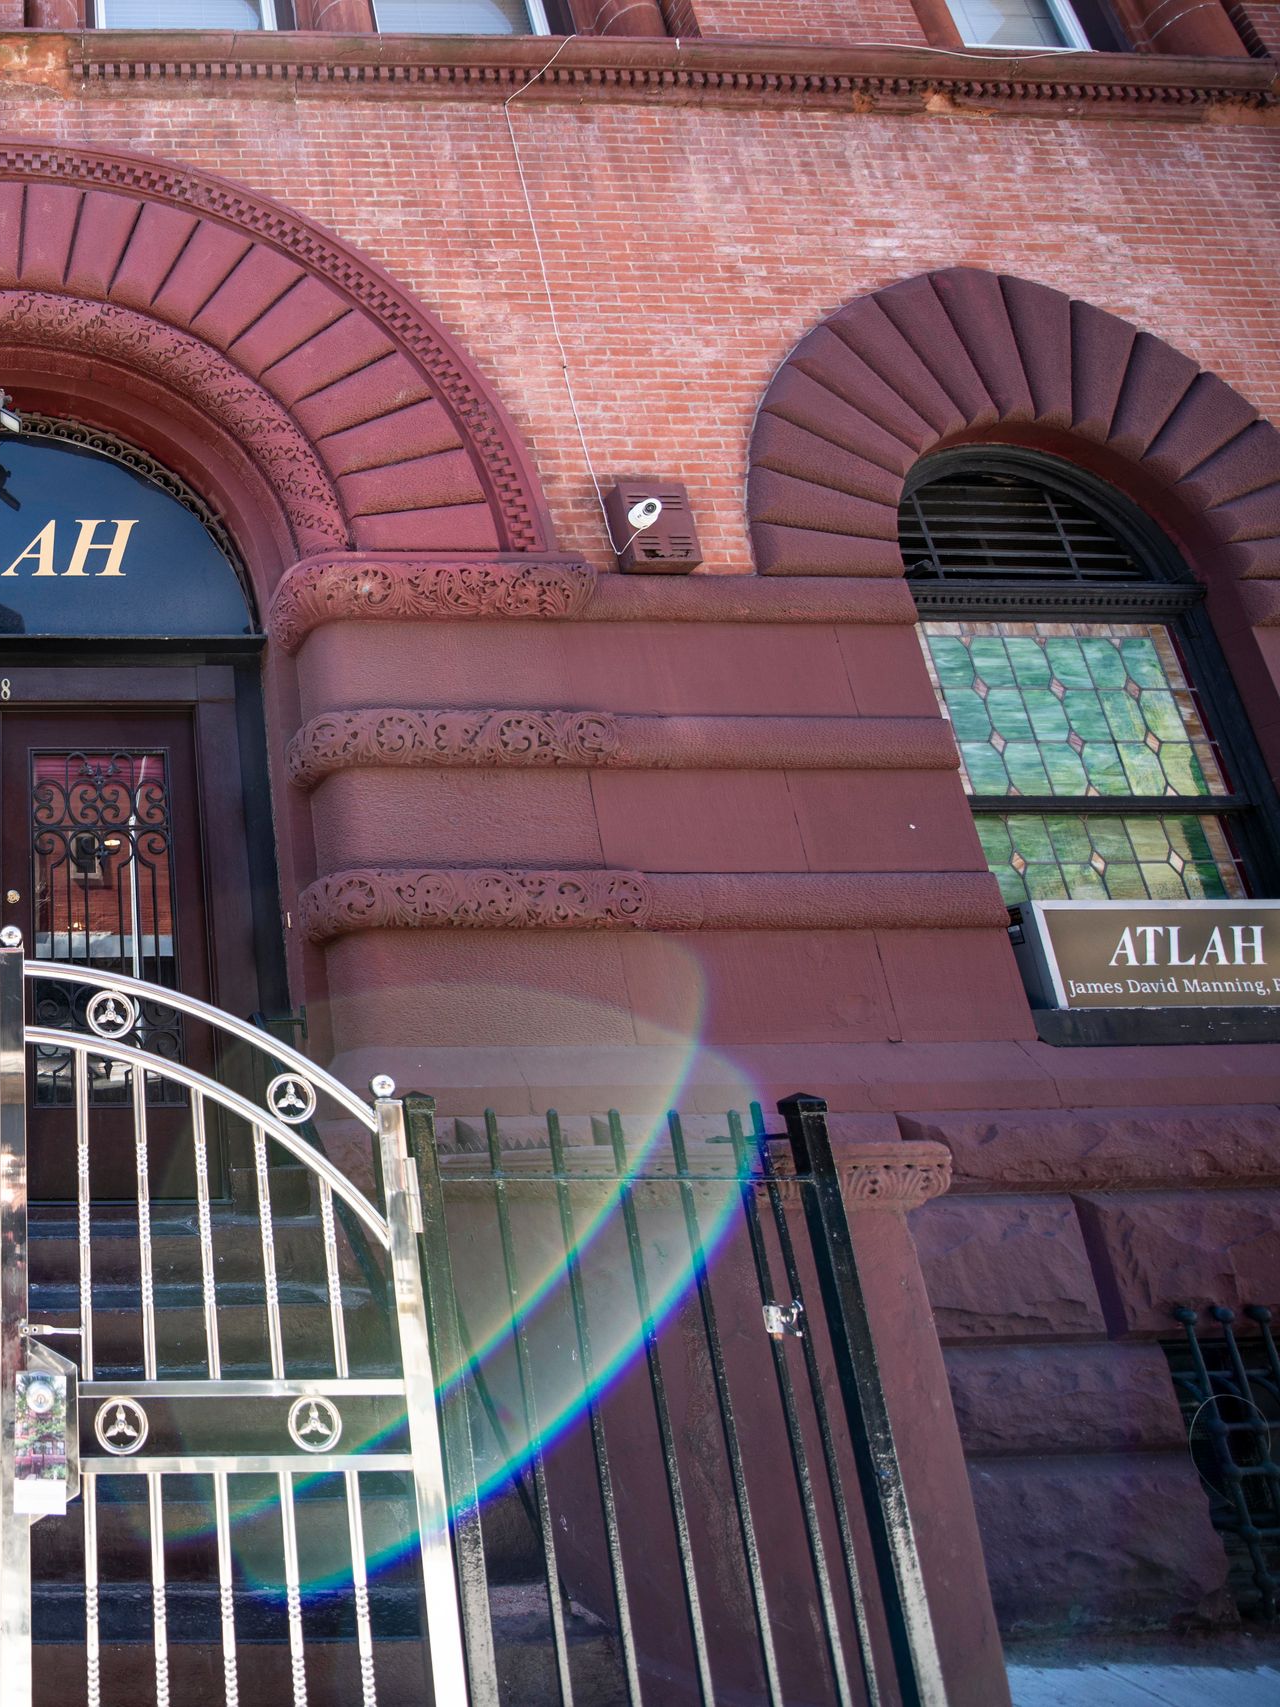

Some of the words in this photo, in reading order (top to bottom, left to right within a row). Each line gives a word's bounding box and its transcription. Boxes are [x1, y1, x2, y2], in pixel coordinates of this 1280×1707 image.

[1108, 925, 1268, 967] ATLAH
[1068, 979, 1123, 998] James
[1126, 977, 1177, 994] David
[1182, 978, 1271, 996] Manning,
